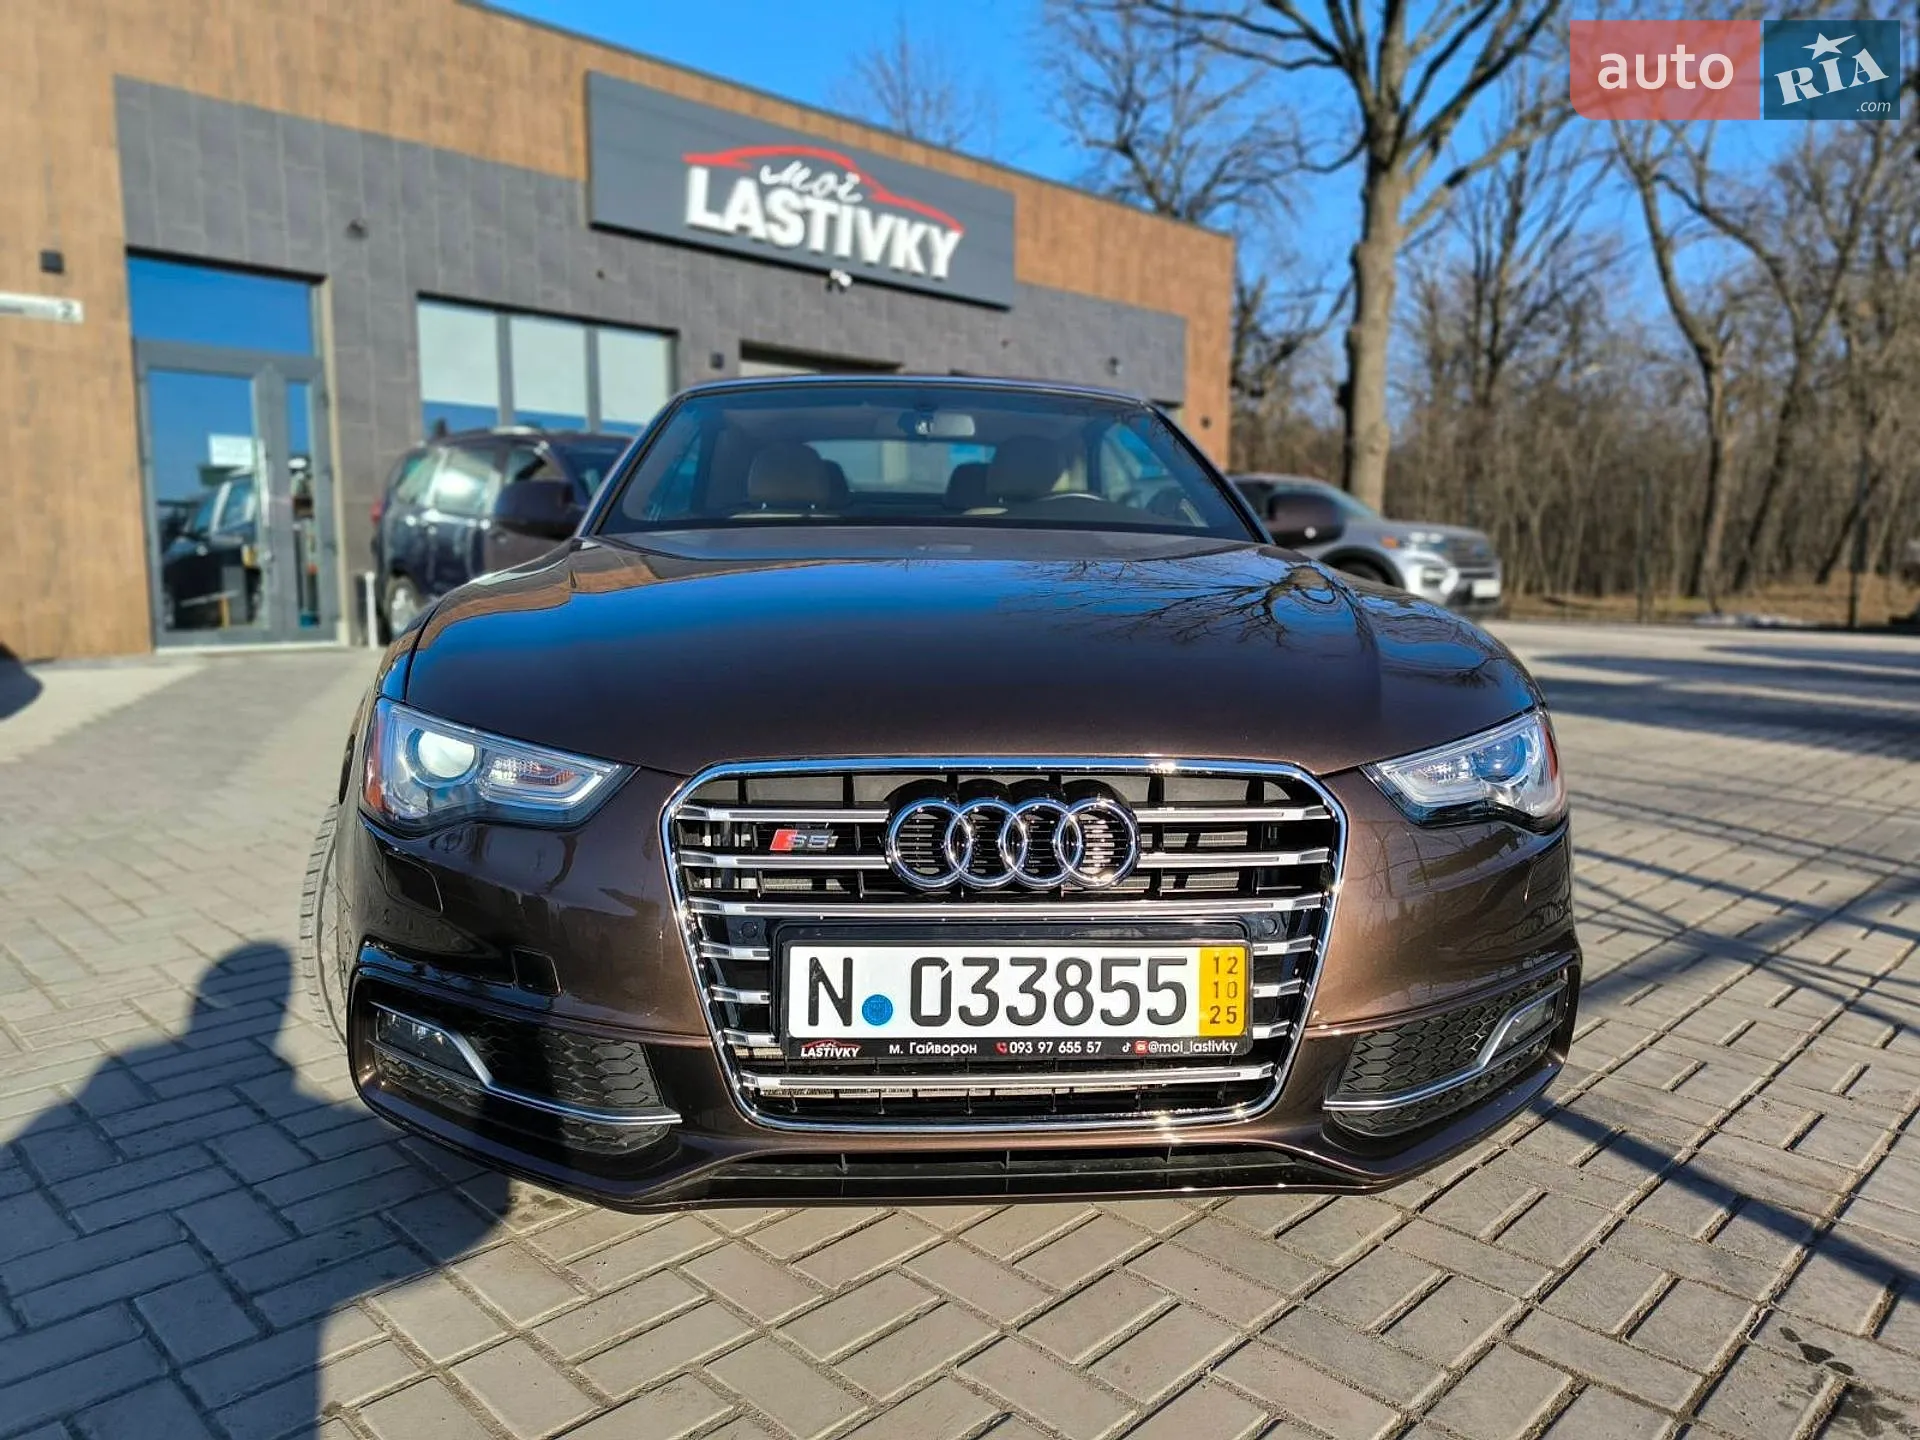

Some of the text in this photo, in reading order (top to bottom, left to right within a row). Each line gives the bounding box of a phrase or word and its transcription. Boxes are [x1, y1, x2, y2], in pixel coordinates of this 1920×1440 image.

[685, 166, 964, 278] LASTIVKY
[1213, 955, 1239, 975] 12
[807, 956, 1188, 1027] N 033855
[1213, 980, 1239, 999] 10
[1209, 1004, 1239, 1025] 25
[800, 1046, 860, 1059] LASTIVKY
[889, 1041, 977, 1057] м. Гайворон
[1009, 1040, 1102, 1054] 093 97 655 57
[1148, 1039, 1238, 1055] @moi_lastivky
